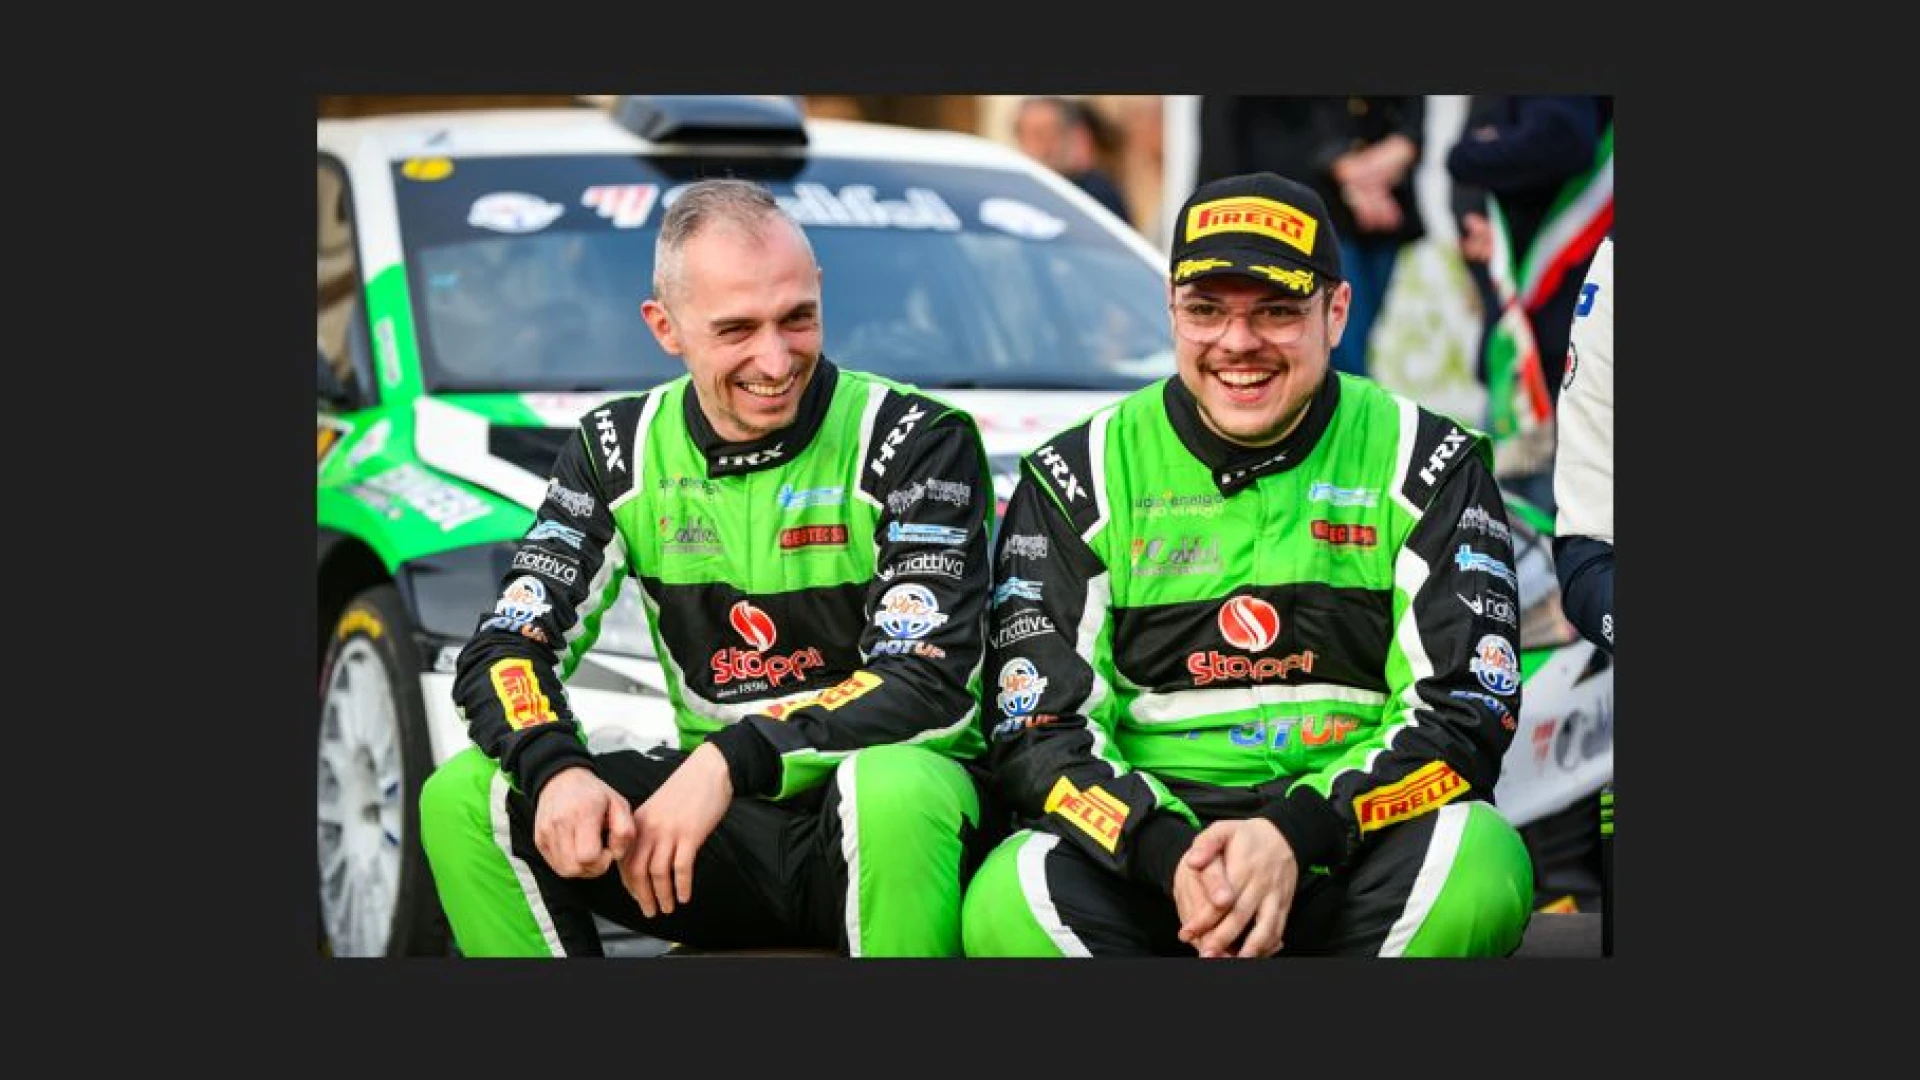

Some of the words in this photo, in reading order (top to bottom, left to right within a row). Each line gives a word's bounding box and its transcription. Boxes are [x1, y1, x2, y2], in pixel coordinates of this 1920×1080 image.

[1197, 206, 1307, 242] PIRELLI
[594, 409, 626, 475] HRX
[870, 403, 927, 478] HRX
[1418, 426, 1468, 487] HRX
[1036, 445, 1088, 502] HRX
[1186, 650, 1315, 686] Stoppi
[1360, 765, 1461, 825] PIRELLI
